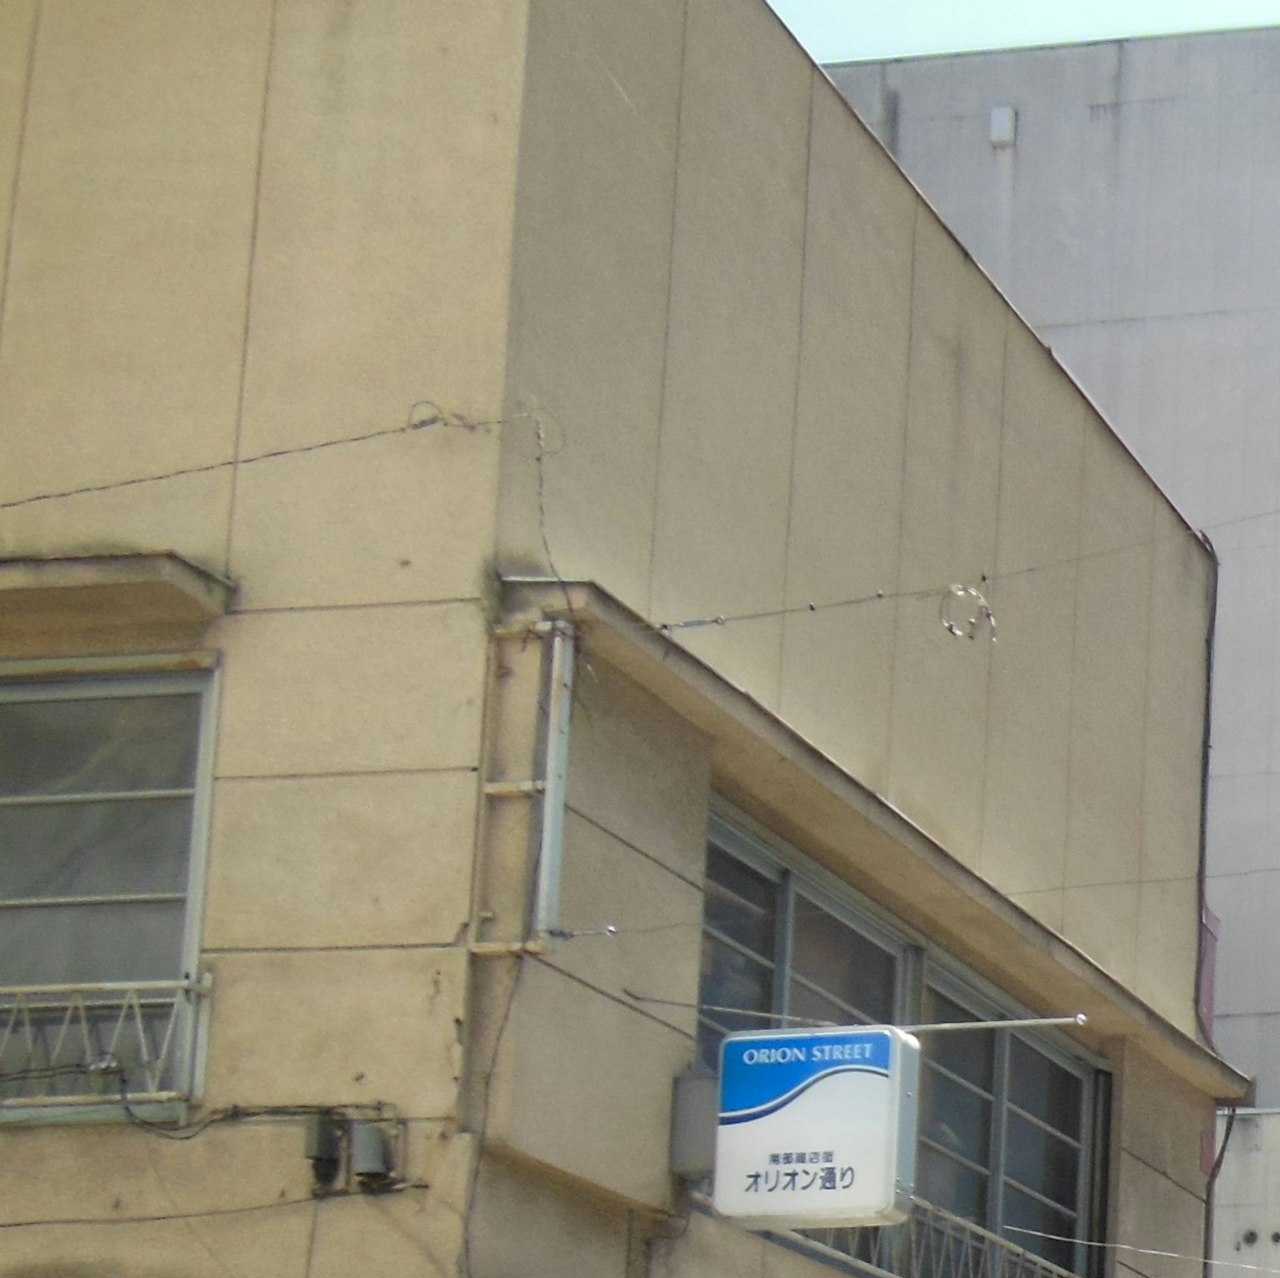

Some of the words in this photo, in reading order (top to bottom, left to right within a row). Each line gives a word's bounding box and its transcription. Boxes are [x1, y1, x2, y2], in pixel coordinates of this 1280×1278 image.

[742, 1046, 807, 1065] ORION
[811, 1043, 874, 1061] STREET
[744, 1166, 855, 1192] オリオン通り
